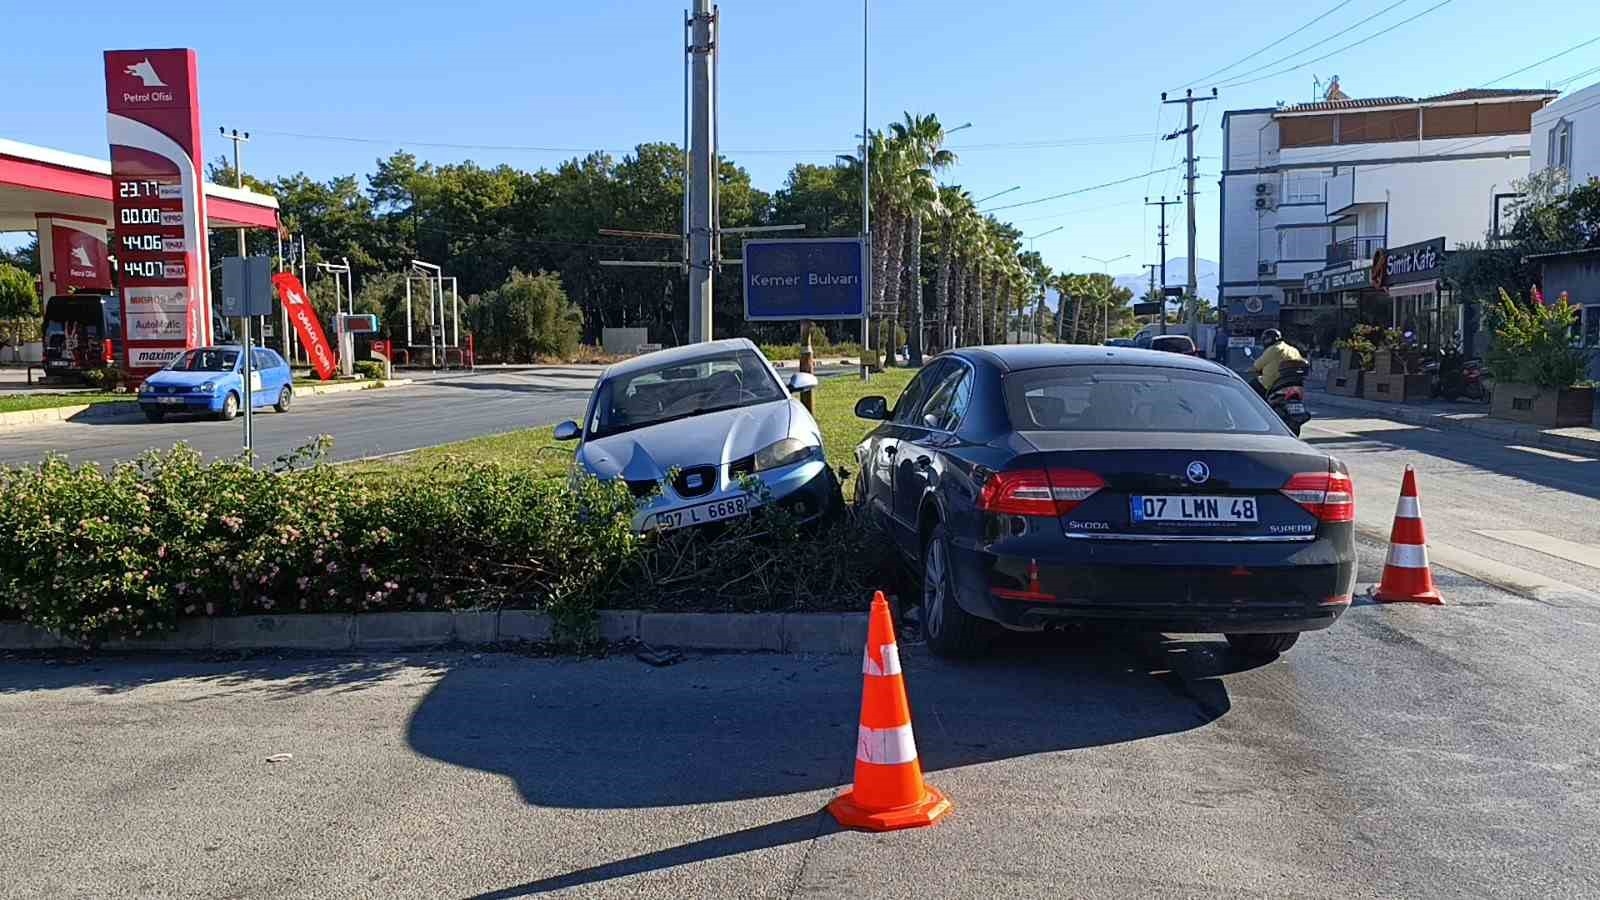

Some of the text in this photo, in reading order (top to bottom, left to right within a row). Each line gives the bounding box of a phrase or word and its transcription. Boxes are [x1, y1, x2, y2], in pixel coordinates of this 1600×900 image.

[123, 91, 173, 103] Petrol Ofisi
[119, 181, 159, 198] 23.77
[121, 208, 160, 225] 00.00
[122, 235, 162, 251] 44.06
[1386, 252, 1412, 276] Simit
[1412, 245, 1437, 272] Kafe
[124, 261, 164, 278] 44.07
[751, 272, 858, 287] Kemer Bulvarı
[665, 498, 745, 527] 07 L 6688
[1143, 498, 1167, 517] 07
[1181, 498, 1219, 518] LMN
[1230, 499, 1255, 519] 48
